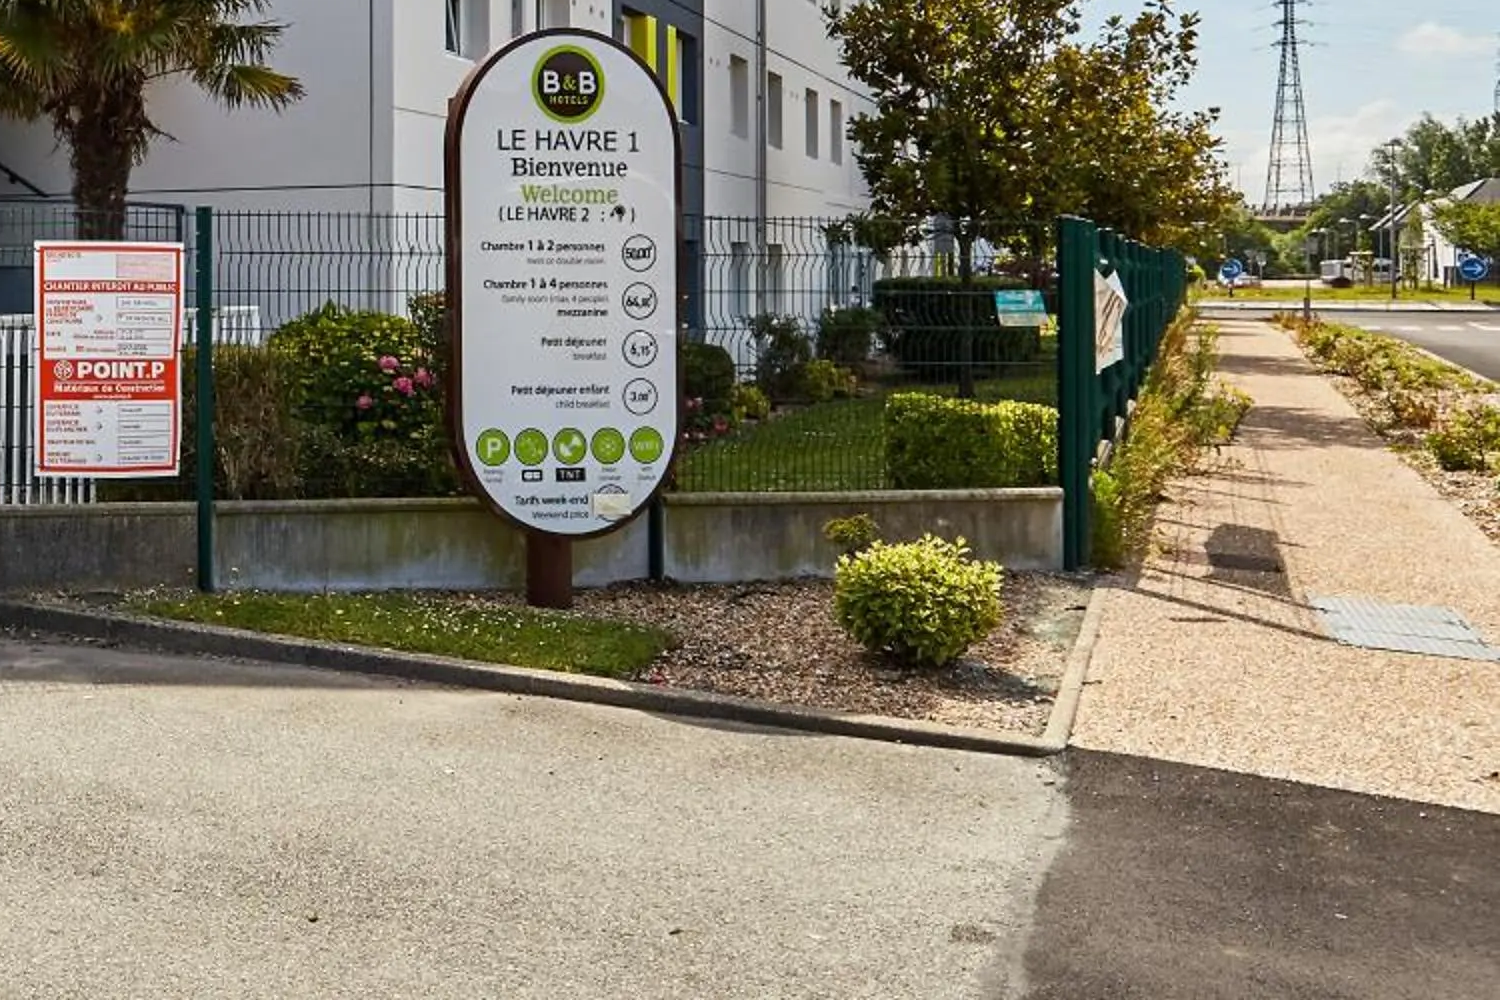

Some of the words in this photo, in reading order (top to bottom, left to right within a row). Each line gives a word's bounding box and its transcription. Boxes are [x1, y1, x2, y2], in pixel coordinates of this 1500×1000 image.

[543, 70, 597, 94] B&B
[549, 95, 589, 105] HOTELS
[497, 129, 526, 150] LE
[535, 130, 617, 151] HAVRE
[627, 132, 640, 152] 1
[511, 157, 628, 177] Bienvenue
[520, 184, 619, 204] Welcome
[527, 207, 577, 222] HAVRE
[581, 207, 589, 222] 2
[481, 241, 525, 251] Chambre
[528, 240, 533, 250] 1
[537, 239, 545, 250] à
[547, 239, 554, 250] 2
[555, 243, 605, 252] personnes
[44, 281, 90, 291] CHANTIER
[91, 281, 131, 292] INTERDIT
[483, 280, 527, 289] Chambre
[530, 278, 535, 288] 1
[540, 277, 546, 288] à
[550, 277, 557, 288] 4
[559, 281, 608, 290] personnes
[557, 309, 608, 317] mezzanine
[541, 337, 563, 347] Petit
[564, 336, 607, 349] déjeuner
[77, 361, 164, 379] POINT.P
[115, 383, 165, 392] Construction
[511, 386, 533, 396] Petit
[535, 385, 577, 397] déjeuner
[579, 384, 610, 395] enfant
[486, 437, 501, 459] P
[559, 469, 581, 480] TNT
